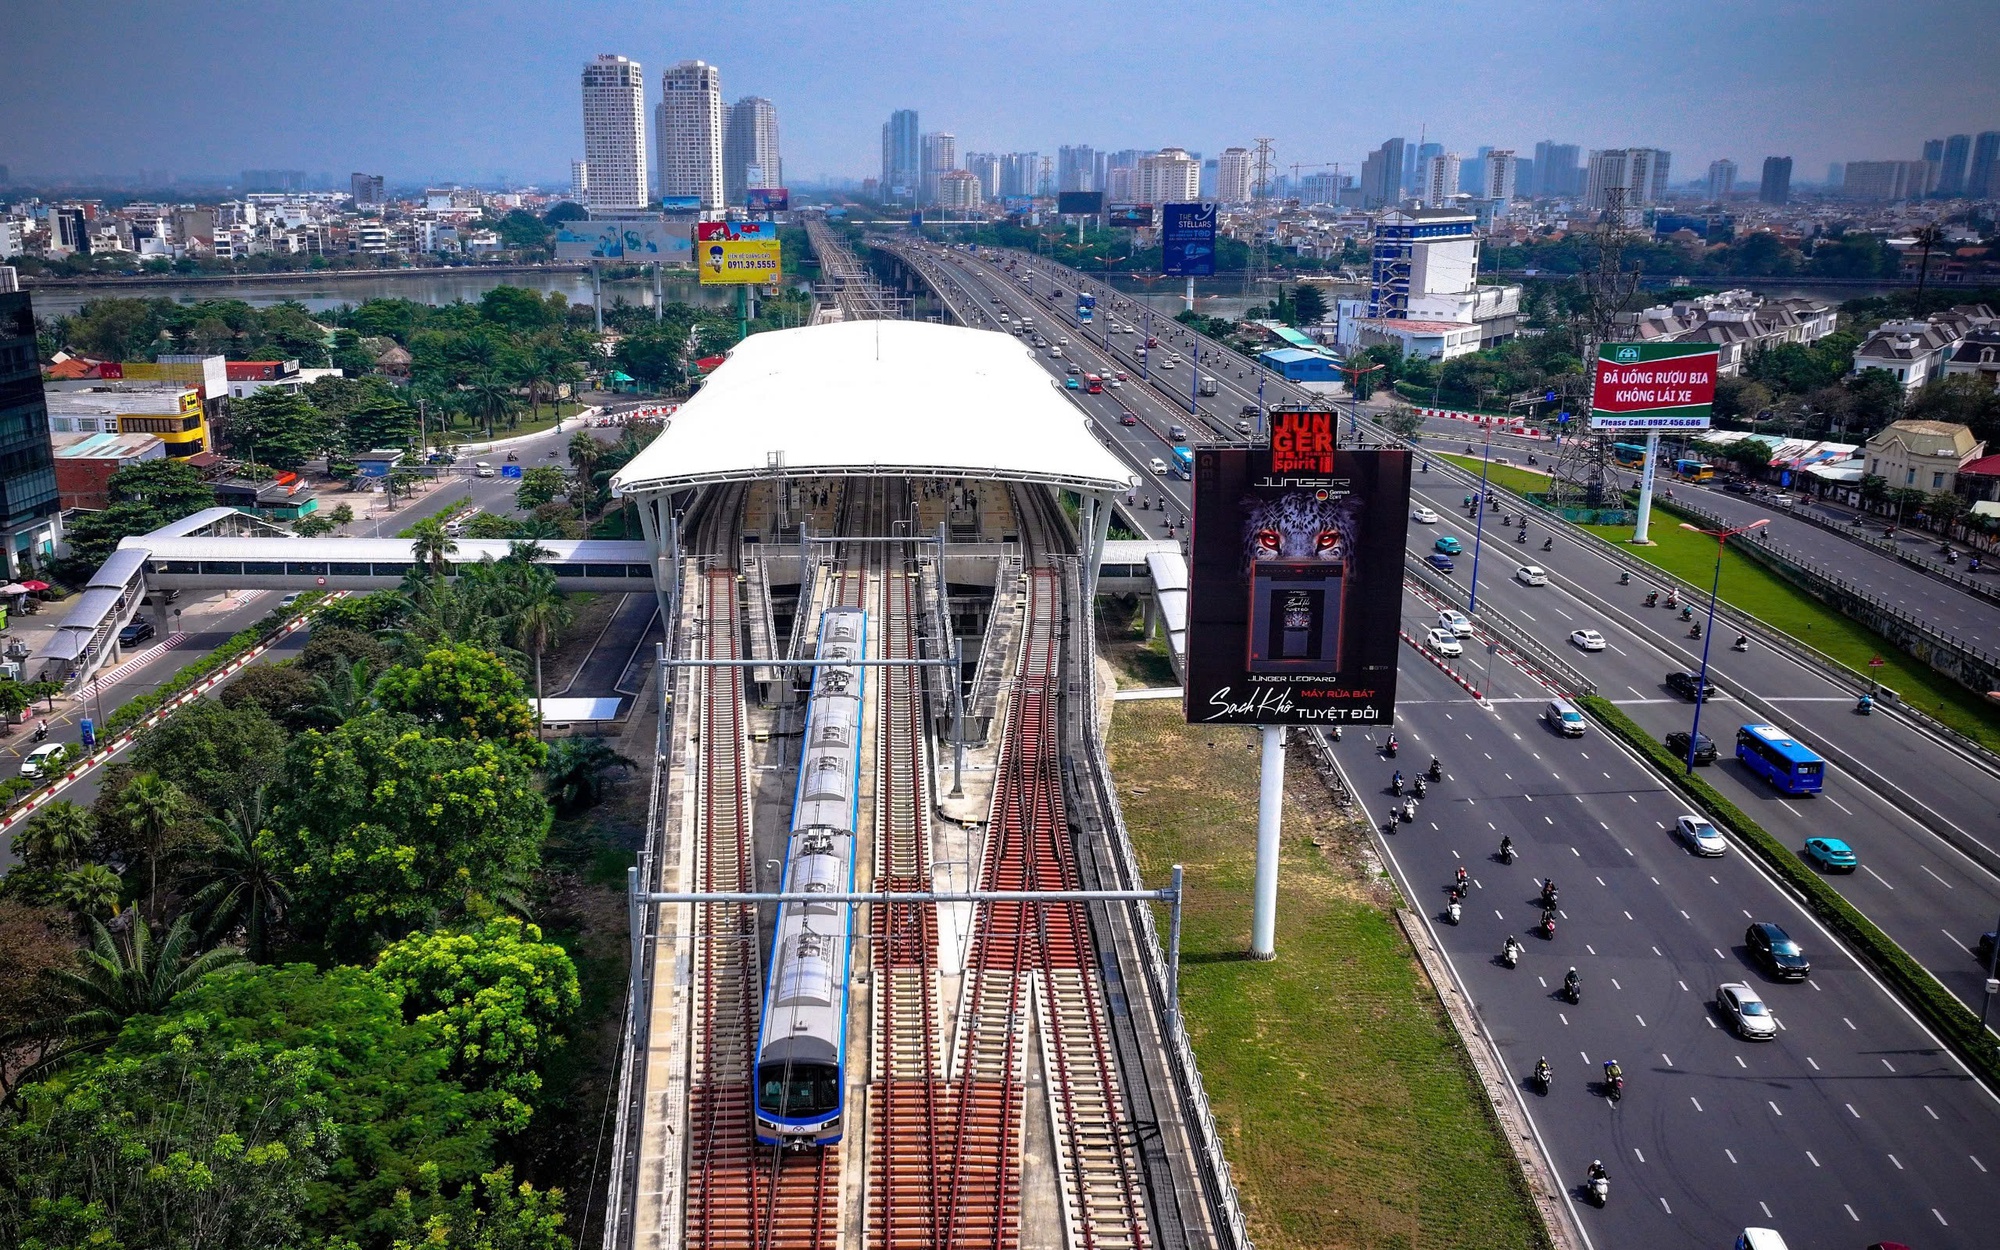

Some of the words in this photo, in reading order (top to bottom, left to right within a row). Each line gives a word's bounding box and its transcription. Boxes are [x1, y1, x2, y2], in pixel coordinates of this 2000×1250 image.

[1178, 213, 1192, 221] THE
[1178, 220, 1212, 228] STELLARS
[727, 260, 776, 269] 0911.39.5555
[1603, 369, 1618, 384] ĐÃ
[1621, 368, 1652, 384] UỐNG
[1655, 369, 1687, 387] RƯỢU
[1689, 372, 1708, 384] BIA
[1615, 387, 1654, 402] KHÔNG
[1657, 386, 1675, 402] LÁI
[1677, 390, 1692, 402] XE
[1274, 413, 1331, 433] JUN
[1600, 419, 1627, 427] Please
[1273, 432, 1333, 452] GER
[1275, 456, 1316, 472] spirit
[1301, 688, 1324, 698] MÁY
[1328, 688, 1351, 698] RỬA
[1353, 688, 1375, 698] BÁT
[1202, 686, 1254, 721] Sạch
[1256, 686, 1295, 718] Khô
[1296, 706, 1348, 721] TUYỆT
[1351, 705, 1379, 719] ĐỐI
